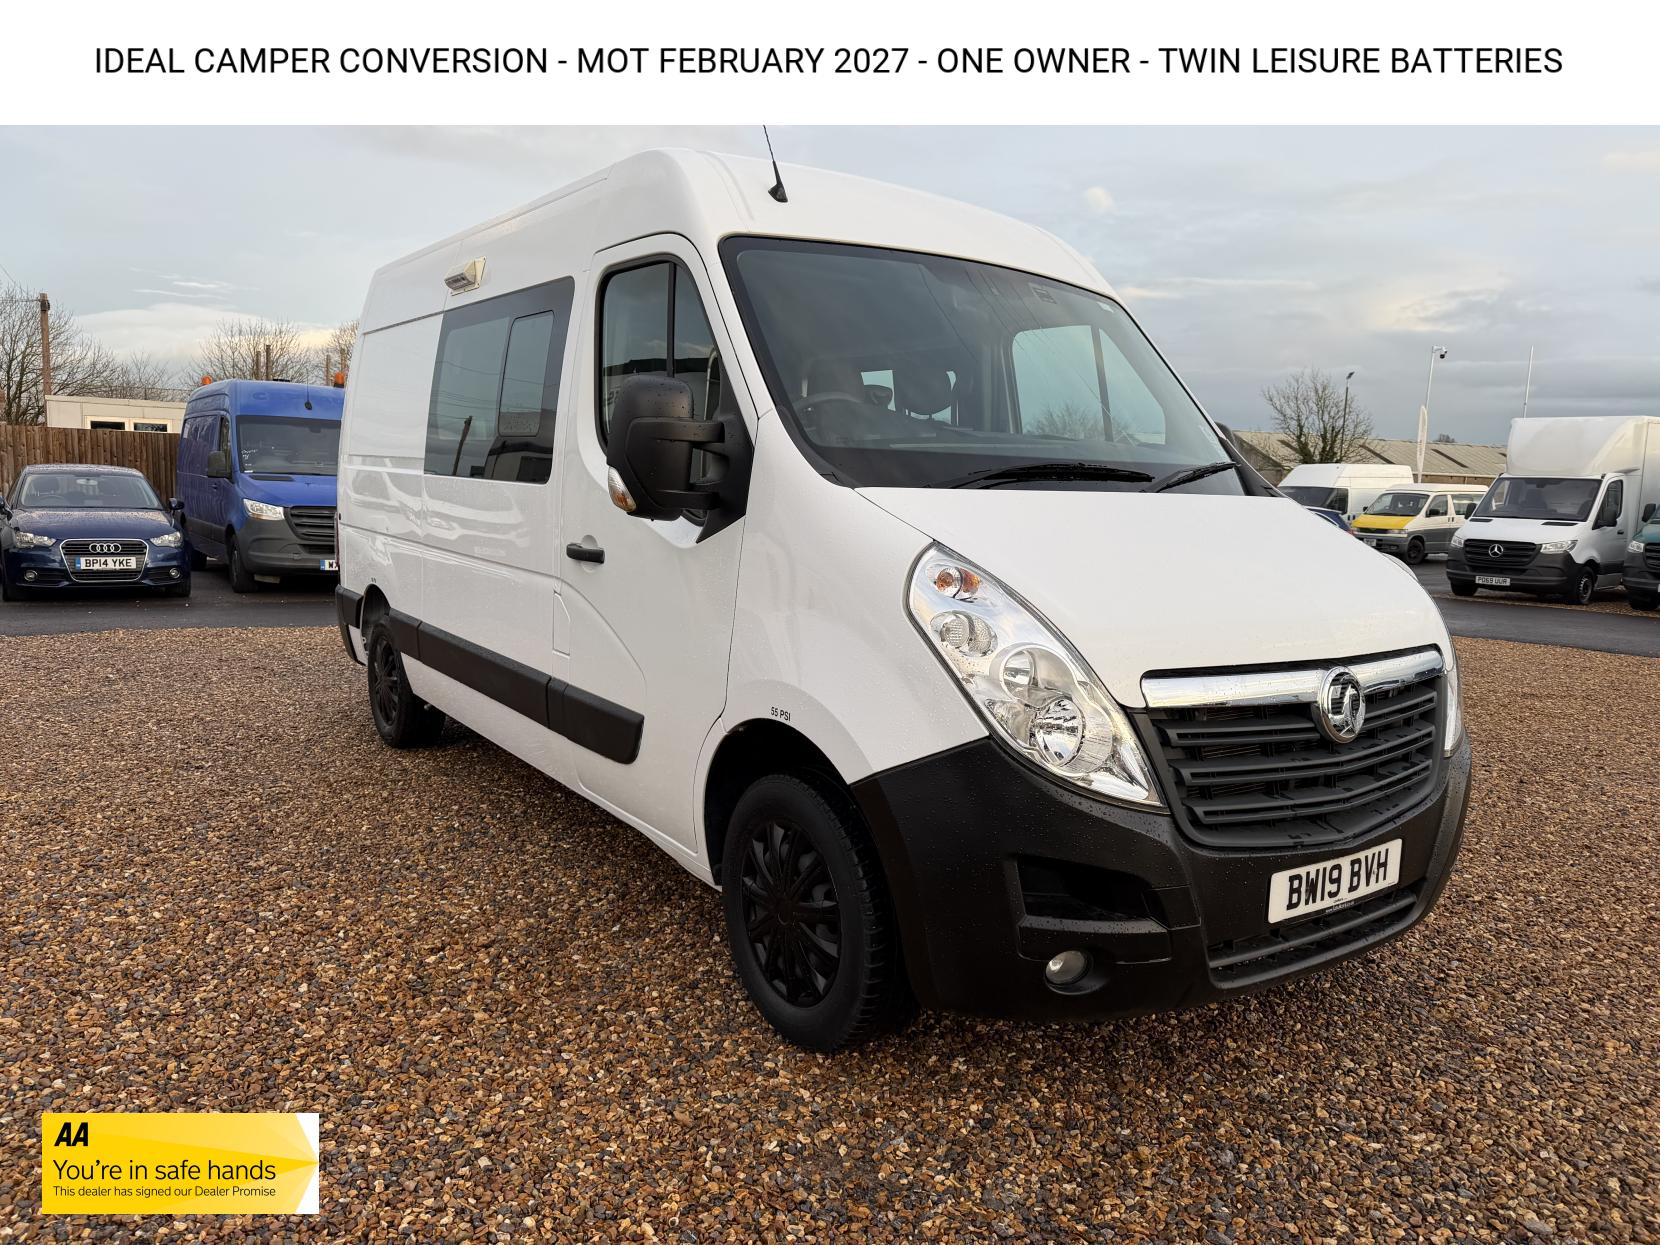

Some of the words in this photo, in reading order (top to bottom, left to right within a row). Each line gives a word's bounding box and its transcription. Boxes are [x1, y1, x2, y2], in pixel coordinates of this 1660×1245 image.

[85, 559, 108, 567] BP14
[112, 559, 131, 567] YKE
[771, 706, 779, 716] 55
[779, 709, 791, 721] PSI
[1286, 863, 1343, 911] BW19
[1347, 848, 1389, 894] BVH
